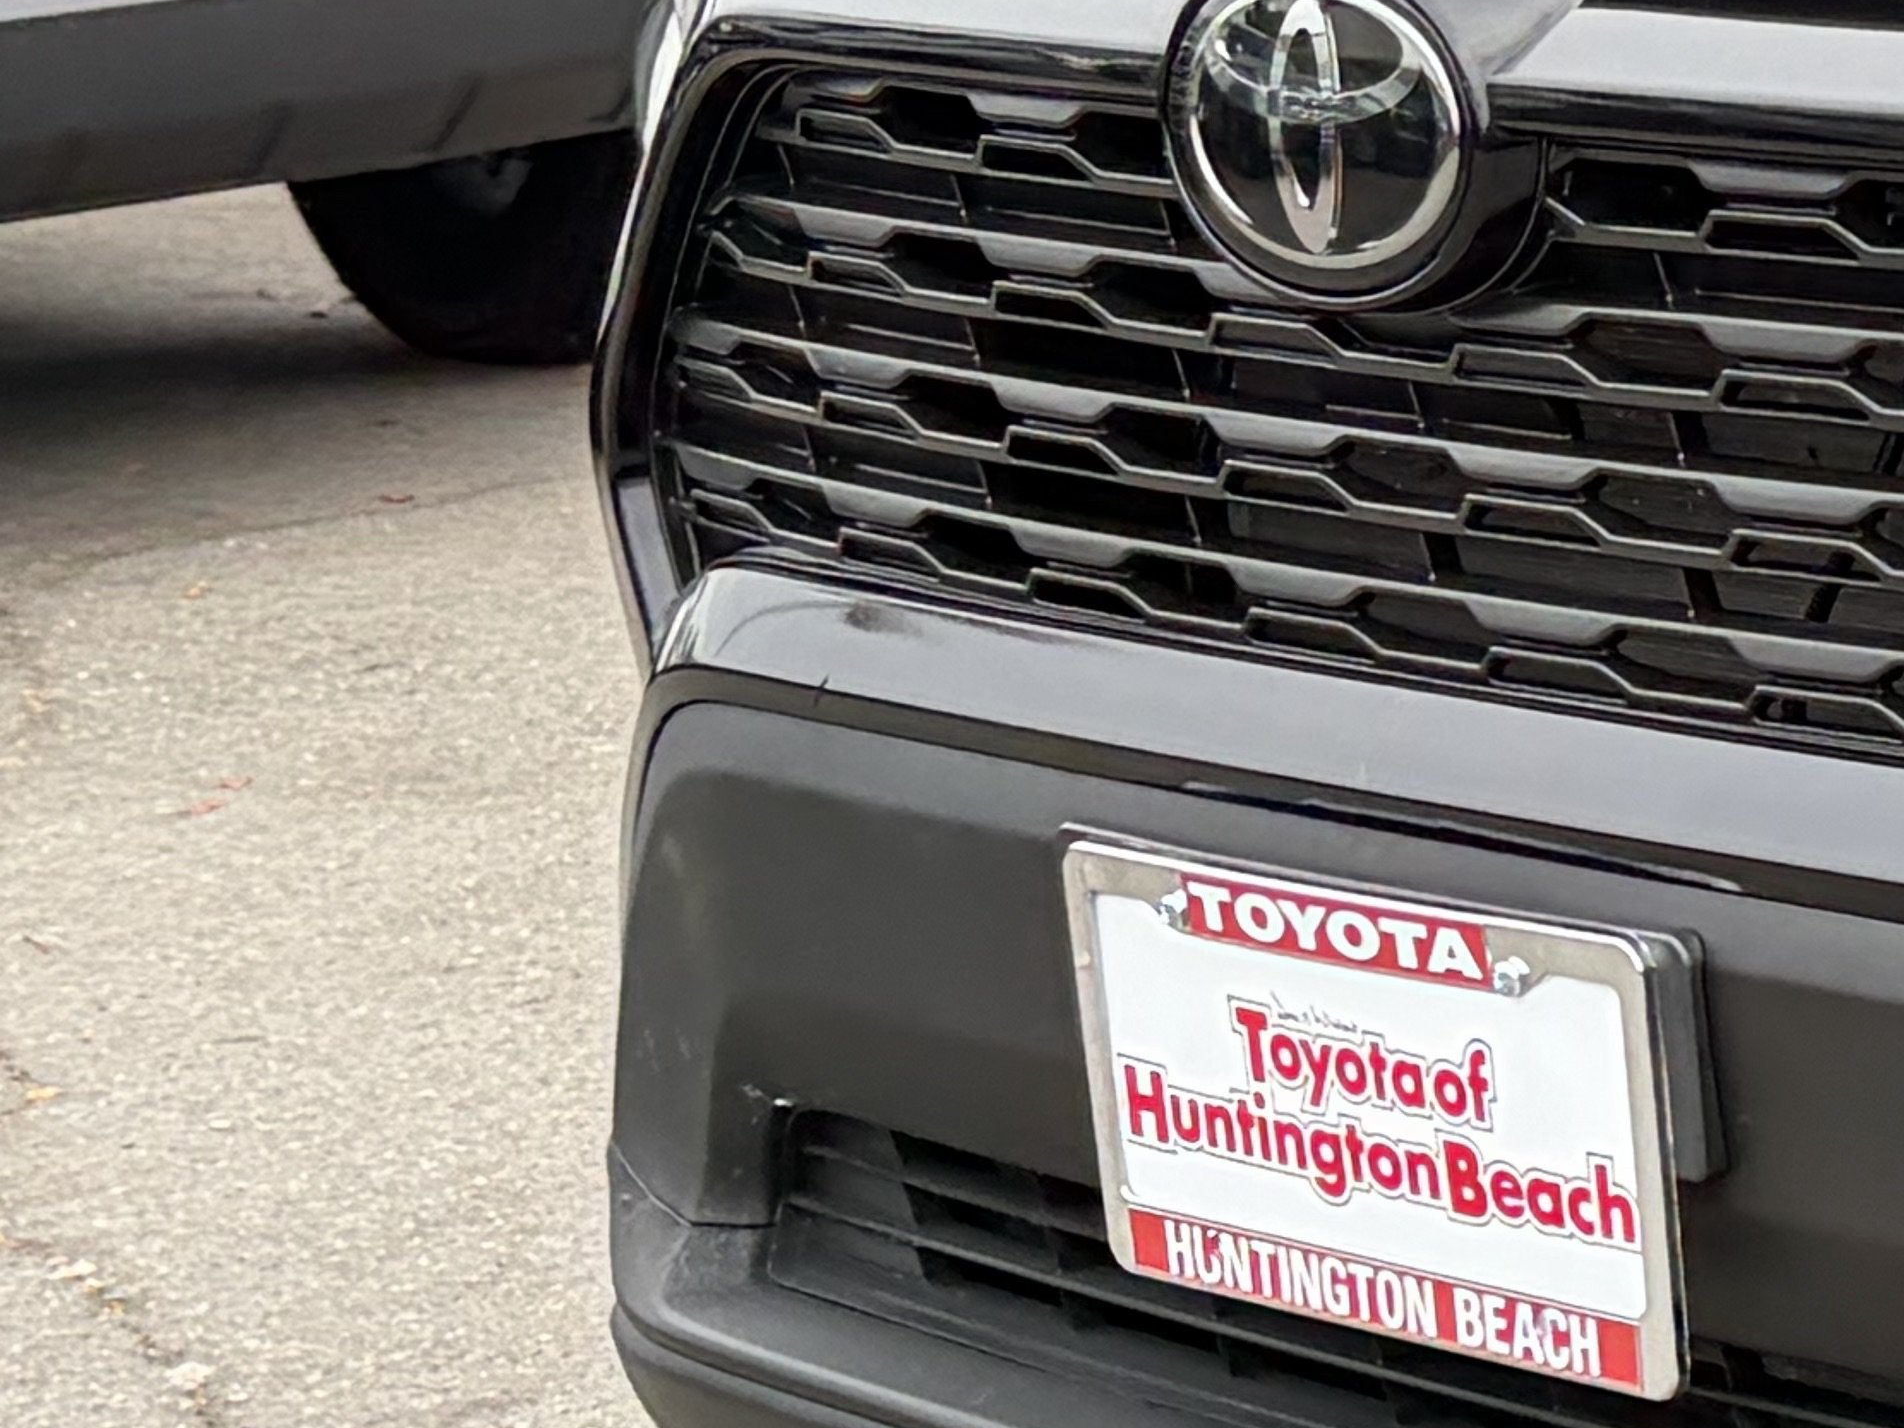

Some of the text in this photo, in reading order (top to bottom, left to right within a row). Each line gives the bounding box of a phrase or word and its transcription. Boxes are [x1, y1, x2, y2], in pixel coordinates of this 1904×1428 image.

[1186, 880, 1484, 981] TOYOTA
[1123, 1064, 1635, 1245] Huntington Beach
[1163, 1218, 1603, 1379] HUNTINGTON BEACH
